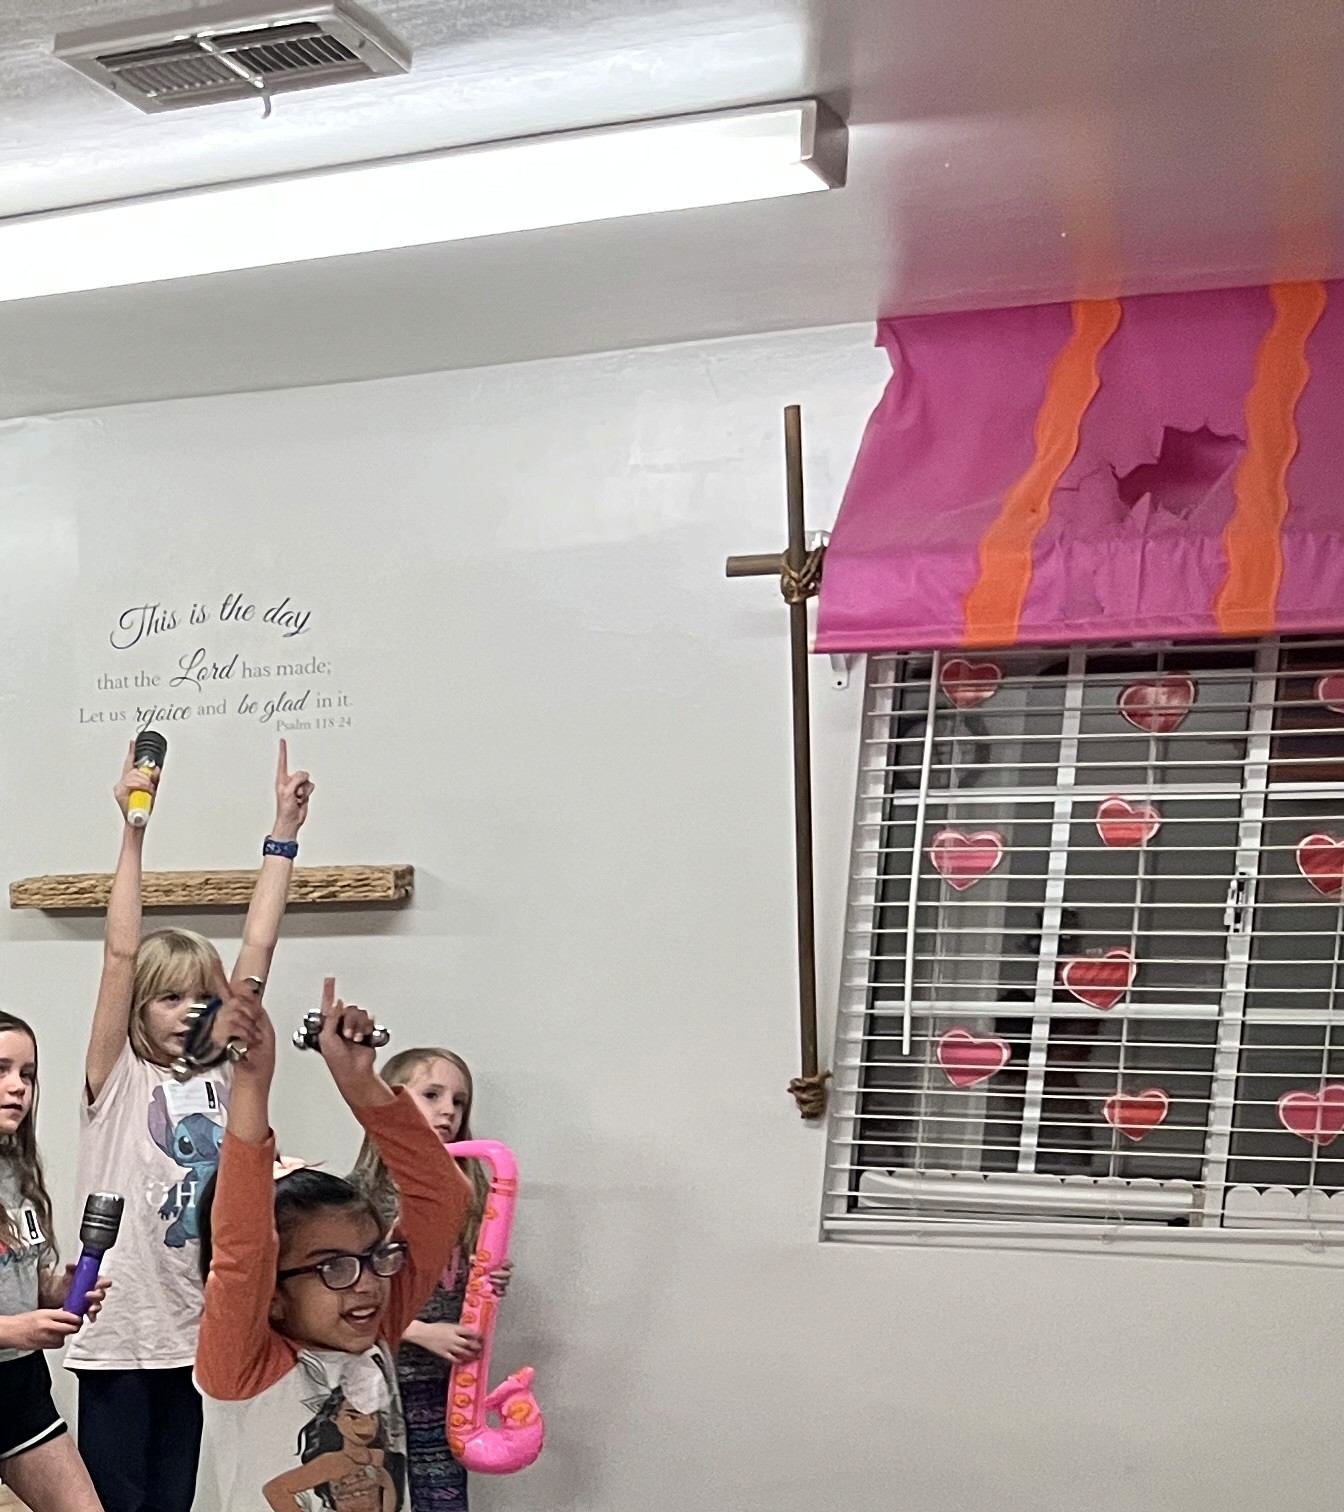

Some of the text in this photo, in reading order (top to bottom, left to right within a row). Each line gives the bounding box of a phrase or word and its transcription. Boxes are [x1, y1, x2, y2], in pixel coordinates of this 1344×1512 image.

[110, 593, 312, 650] This is the day
[97, 648, 332, 692] that the Lord has made;
[79, 708, 104, 724] Let
[109, 710, 127, 722] us
[135, 703, 192, 735] rejoice
[197, 698, 227, 716] and
[237, 693, 259, 715] be
[259, 689, 311, 723] glad
[316, 691, 333, 708] in
[276, 718, 312, 732] Psalm
